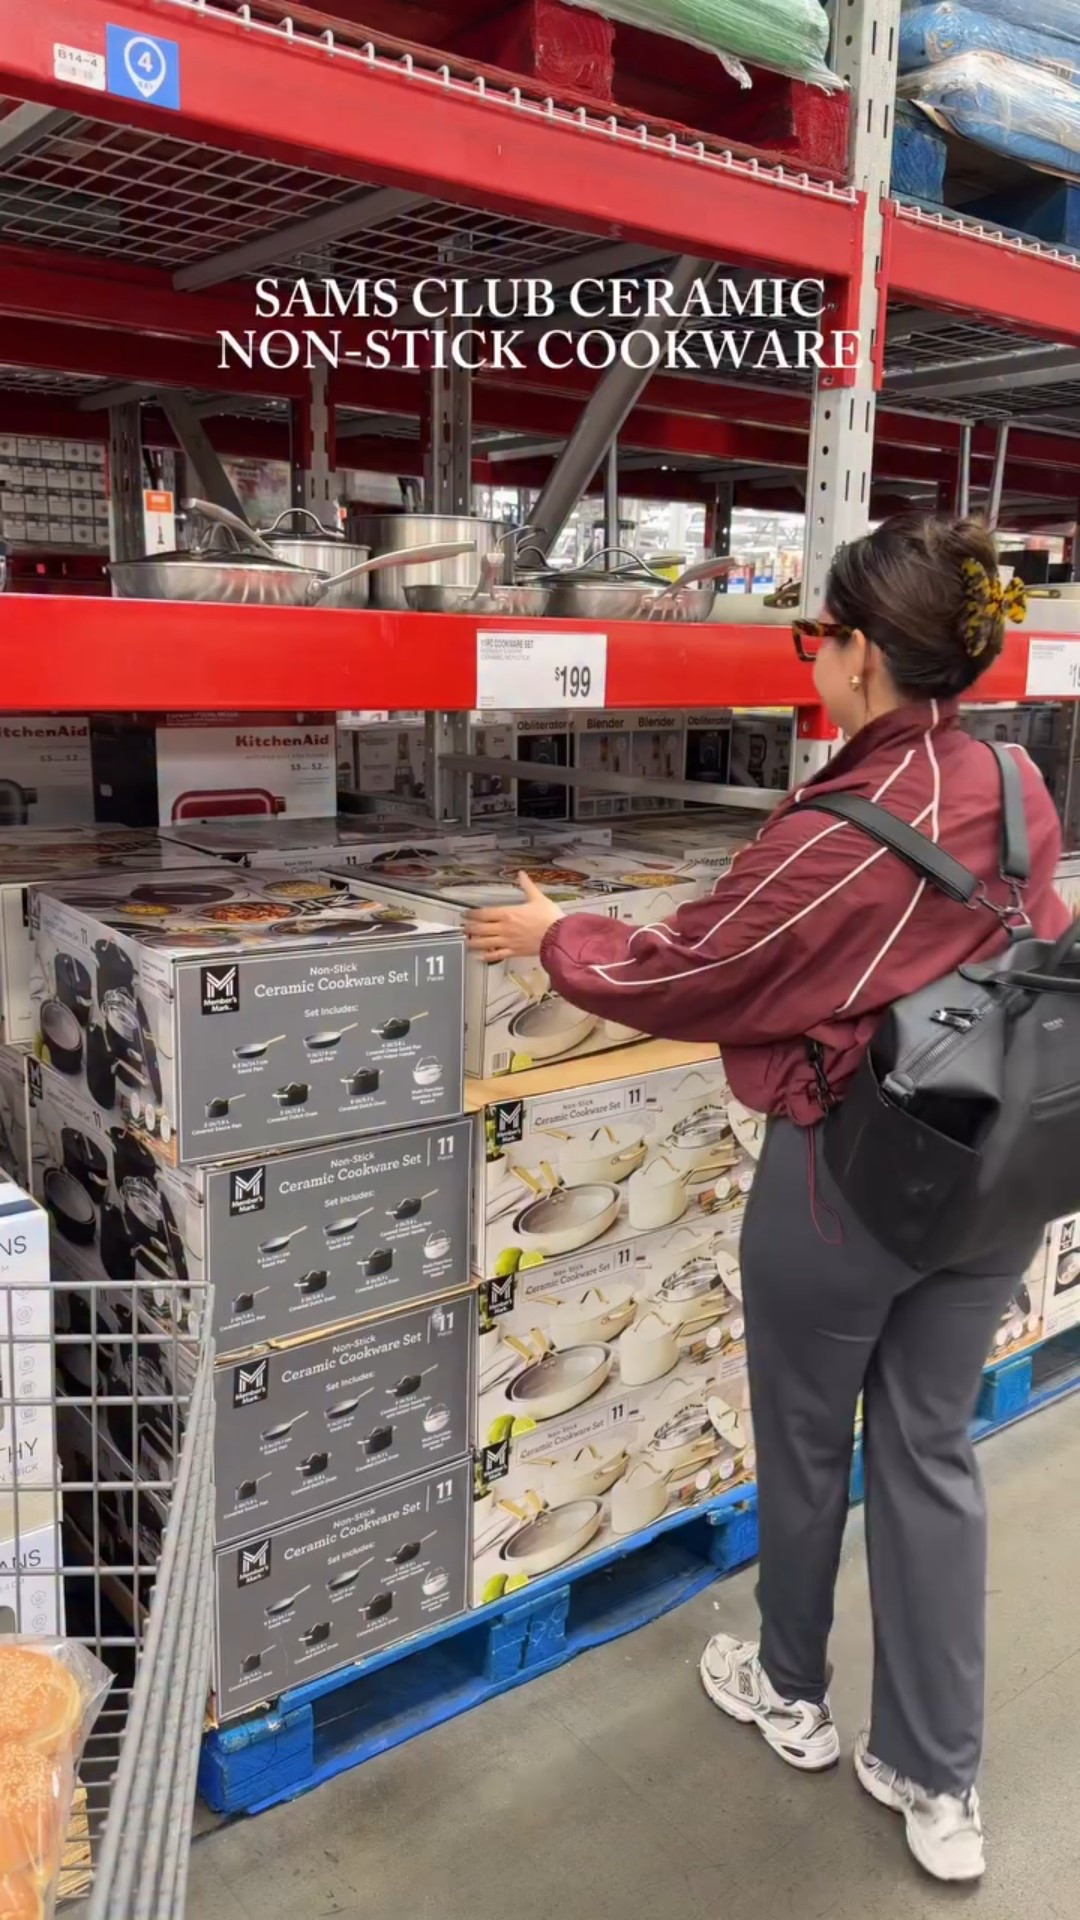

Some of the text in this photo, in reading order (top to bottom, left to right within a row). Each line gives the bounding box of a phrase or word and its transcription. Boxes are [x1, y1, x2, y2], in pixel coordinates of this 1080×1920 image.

[138, 51, 153, 72] 4
[554, 665, 592, 698] $199
[586, 718, 625, 730] Blender
[638, 716, 678, 728] Blender
[235, 733, 330, 748] KitchenAid
[310, 963, 358, 976] Non-Stick
[425, 955, 444, 975] 11
[254, 970, 409, 998] Ceramic Cookware Set
[304, 1004, 359, 1018] Set Includes:
[629, 1088, 641, 1105] 11
[437, 1135, 454, 1155] 11
[330, 1151, 377, 1168] Non-Stick
[278, 1153, 422, 1194] Ceramic Cookware Set
[323, 1197, 339, 1208] Set
[618, 1248, 630, 1264] 11
[332, 1334, 377, 1354] Non-Stick
[281, 1332, 422, 1383] Ceramic Cookware Set
[612, 1403, 624, 1421] 11
[0, 1437, 38, 1463] HY
[436, 1479, 452, 1500] 11
[284, 1501, 421, 1560] Ceramic Cookware Set
